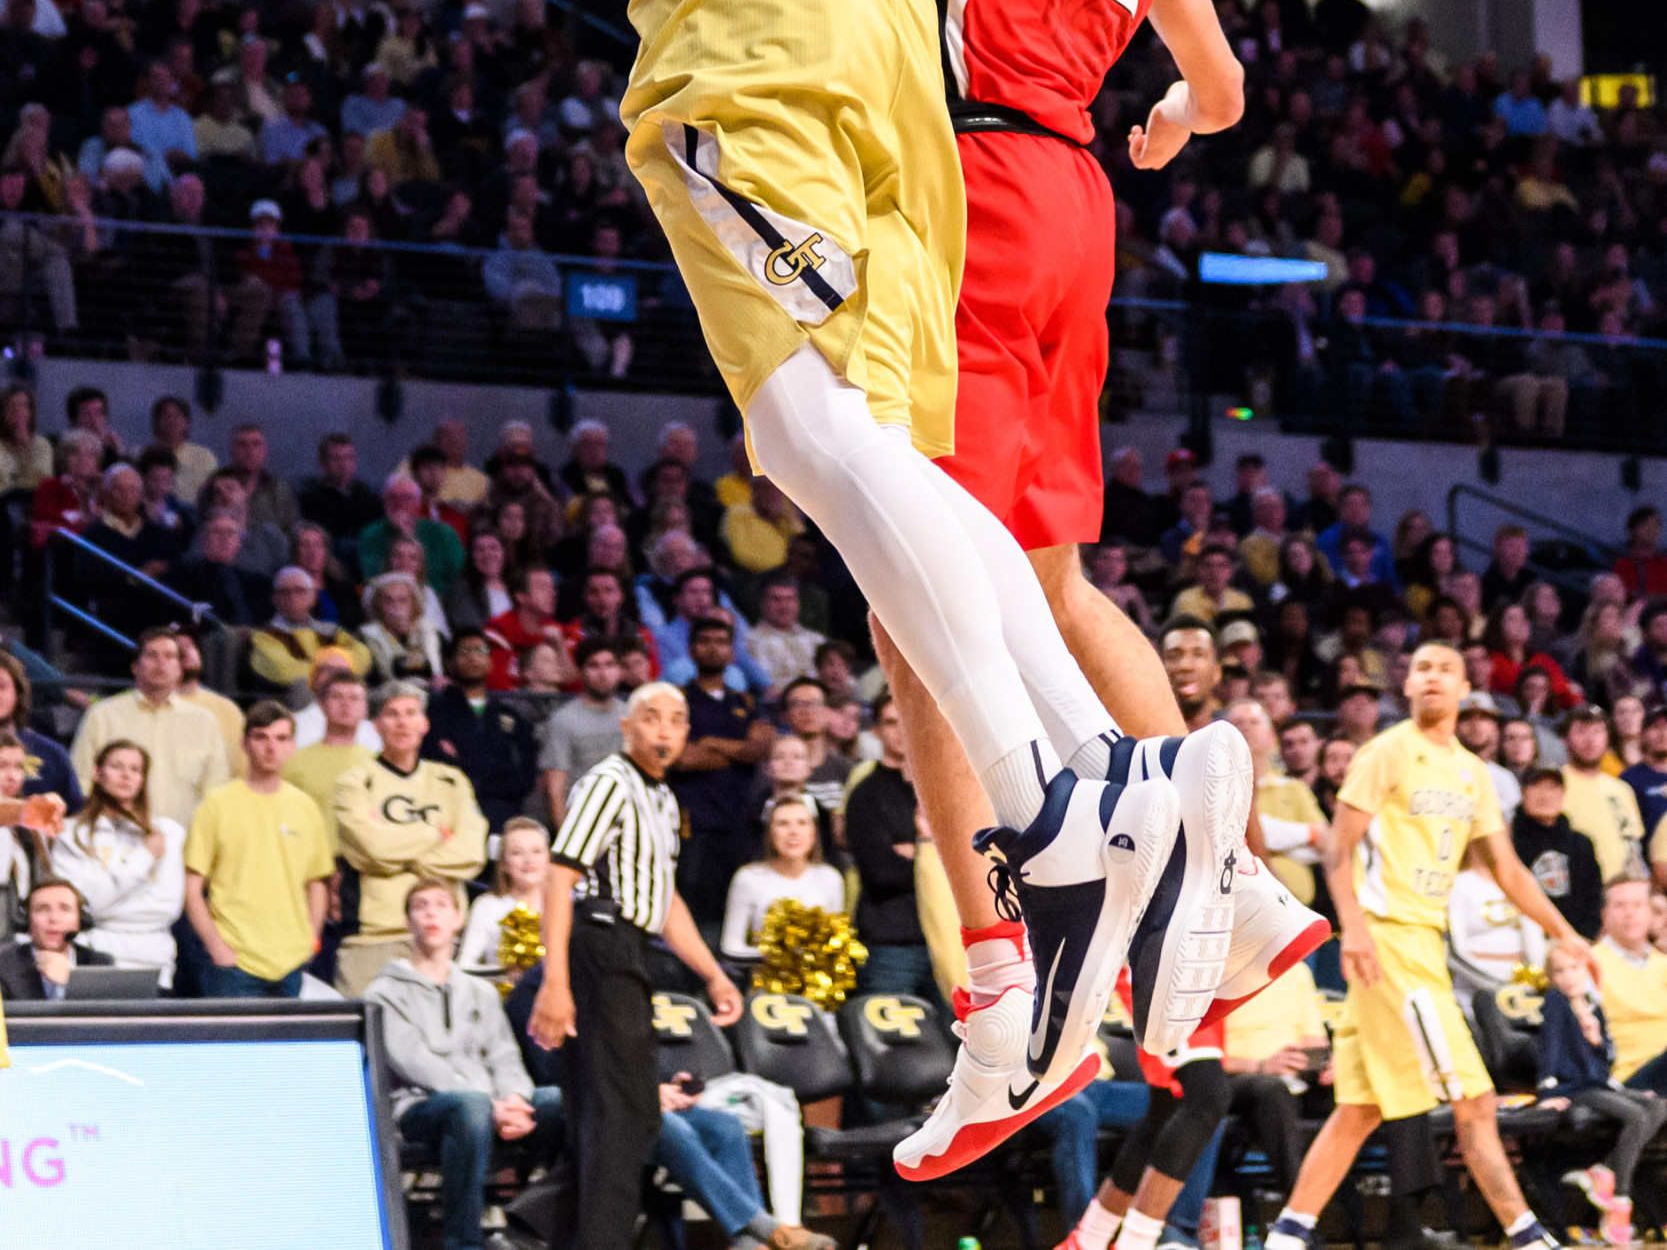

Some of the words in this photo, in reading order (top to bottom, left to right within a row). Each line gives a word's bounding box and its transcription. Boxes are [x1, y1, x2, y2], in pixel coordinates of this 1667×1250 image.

[764, 232, 827, 286] GT
[751, 994, 813, 1036] GT
[864, 996, 926, 1038] GT
